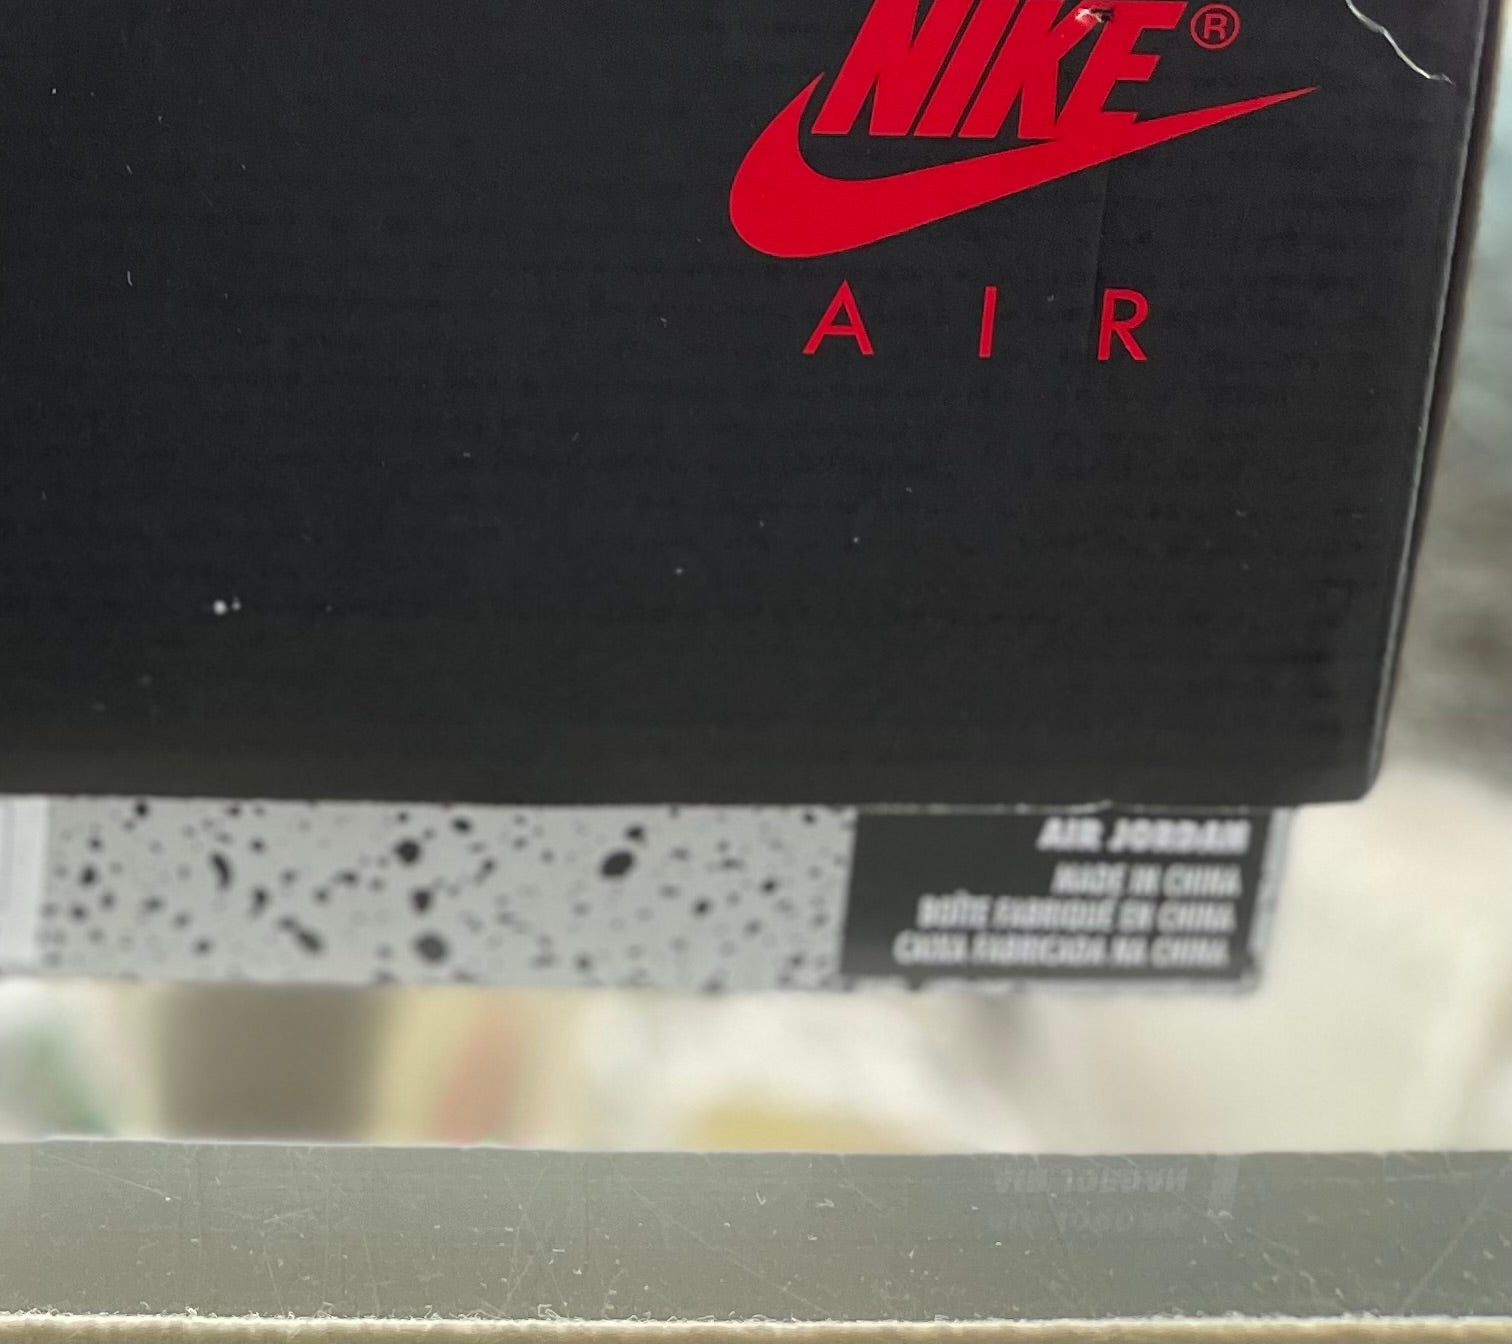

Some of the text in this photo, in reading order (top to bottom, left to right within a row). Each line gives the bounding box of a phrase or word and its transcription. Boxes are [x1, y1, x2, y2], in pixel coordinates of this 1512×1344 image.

[802, 279, 1150, 361] AIR
[1036, 817, 1251, 855] AIR JORDAN
[1050, 862, 1243, 899] MADE IN CHINA
